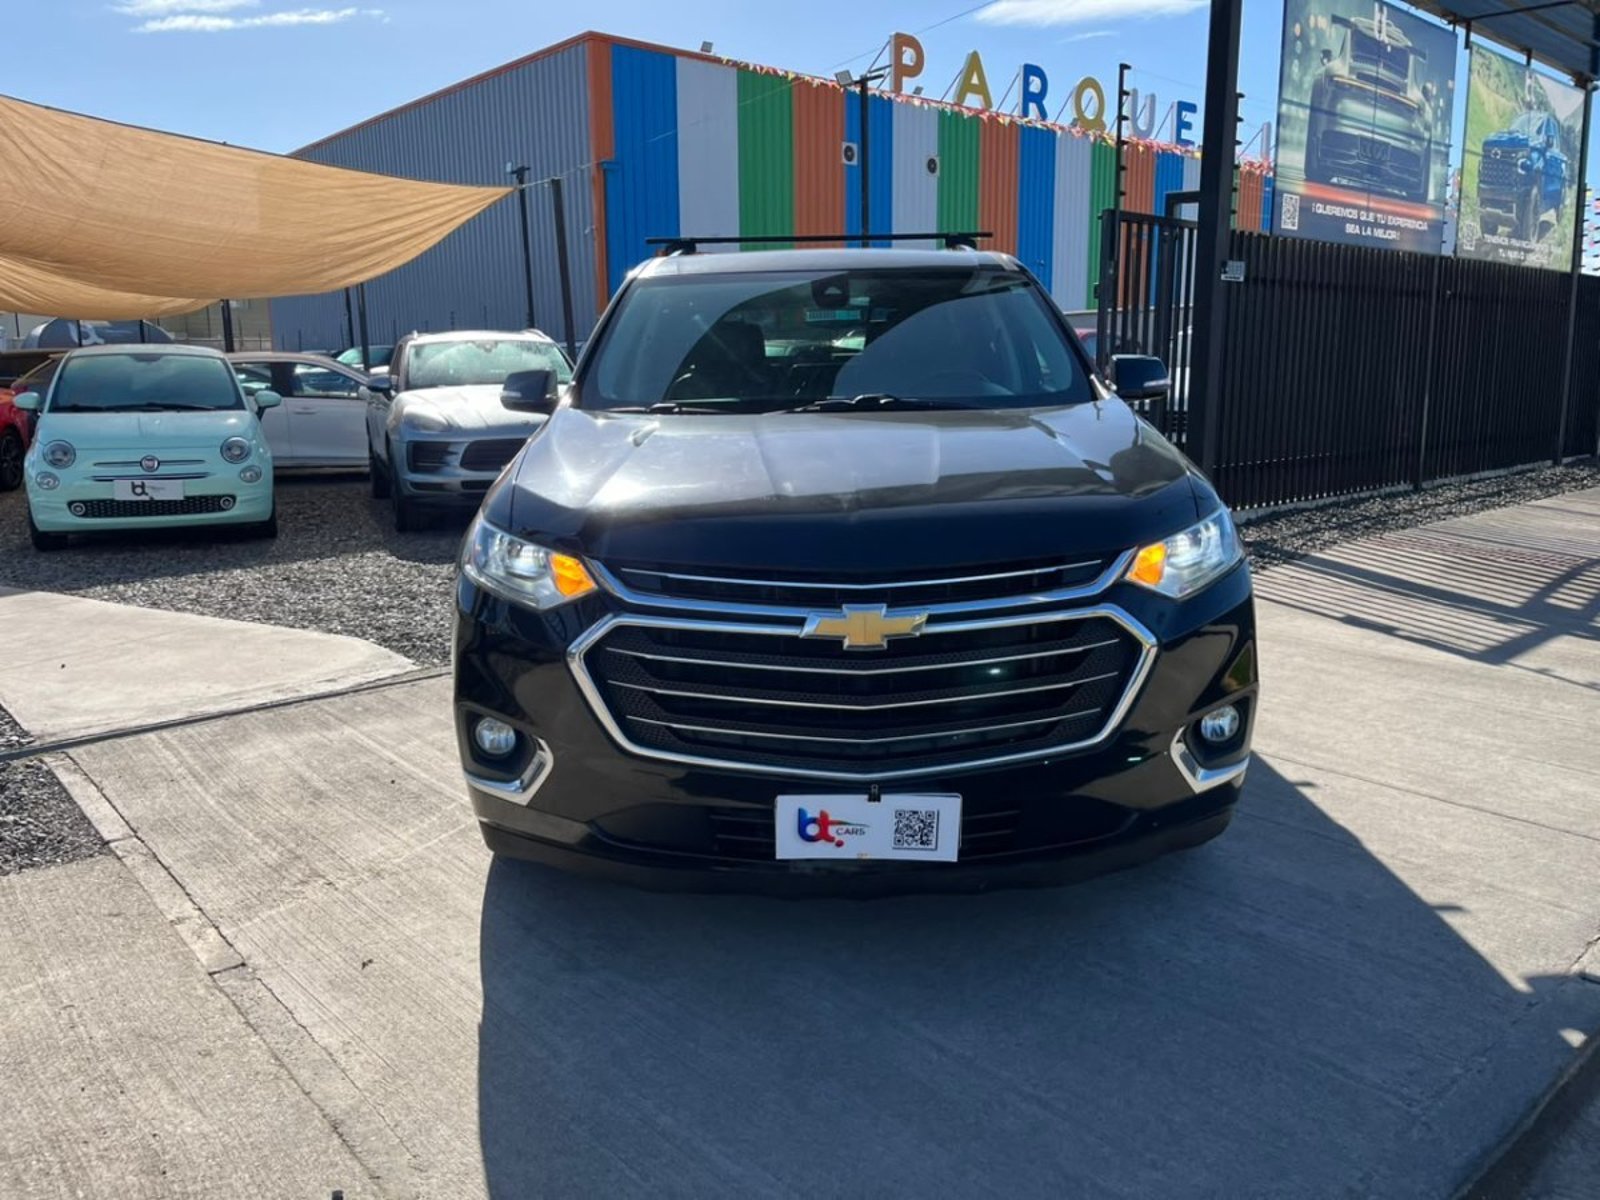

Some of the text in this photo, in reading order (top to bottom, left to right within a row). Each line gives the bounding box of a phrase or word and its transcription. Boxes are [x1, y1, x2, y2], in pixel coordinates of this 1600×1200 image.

[890, 32, 1198, 147] PARQUE
[1360, 210, 1375, 222] QUE
[1377, 213, 1387, 224] TU
[1345, 223, 1361, 235] SEA
[1362, 225, 1372, 236] LA
[836, 828, 866, 836] CARS
